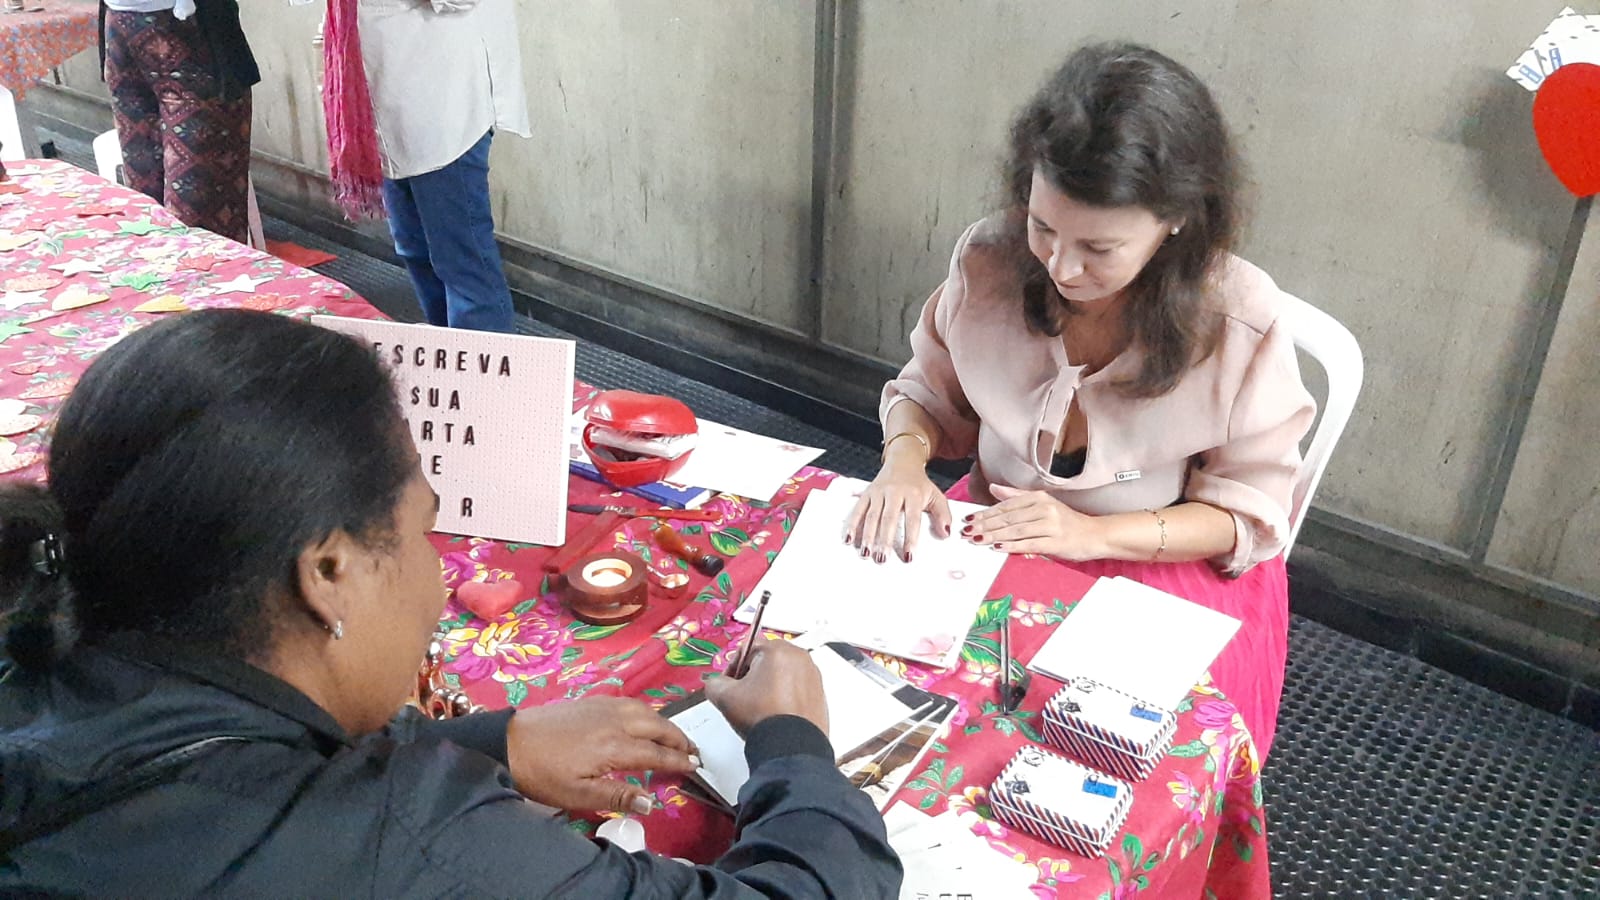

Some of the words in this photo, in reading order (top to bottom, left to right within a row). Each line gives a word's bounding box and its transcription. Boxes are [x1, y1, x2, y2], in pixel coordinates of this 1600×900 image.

[411, 386, 461, 410] SUA
[422, 420, 475, 446] RTA
[432, 455, 442, 475] E
